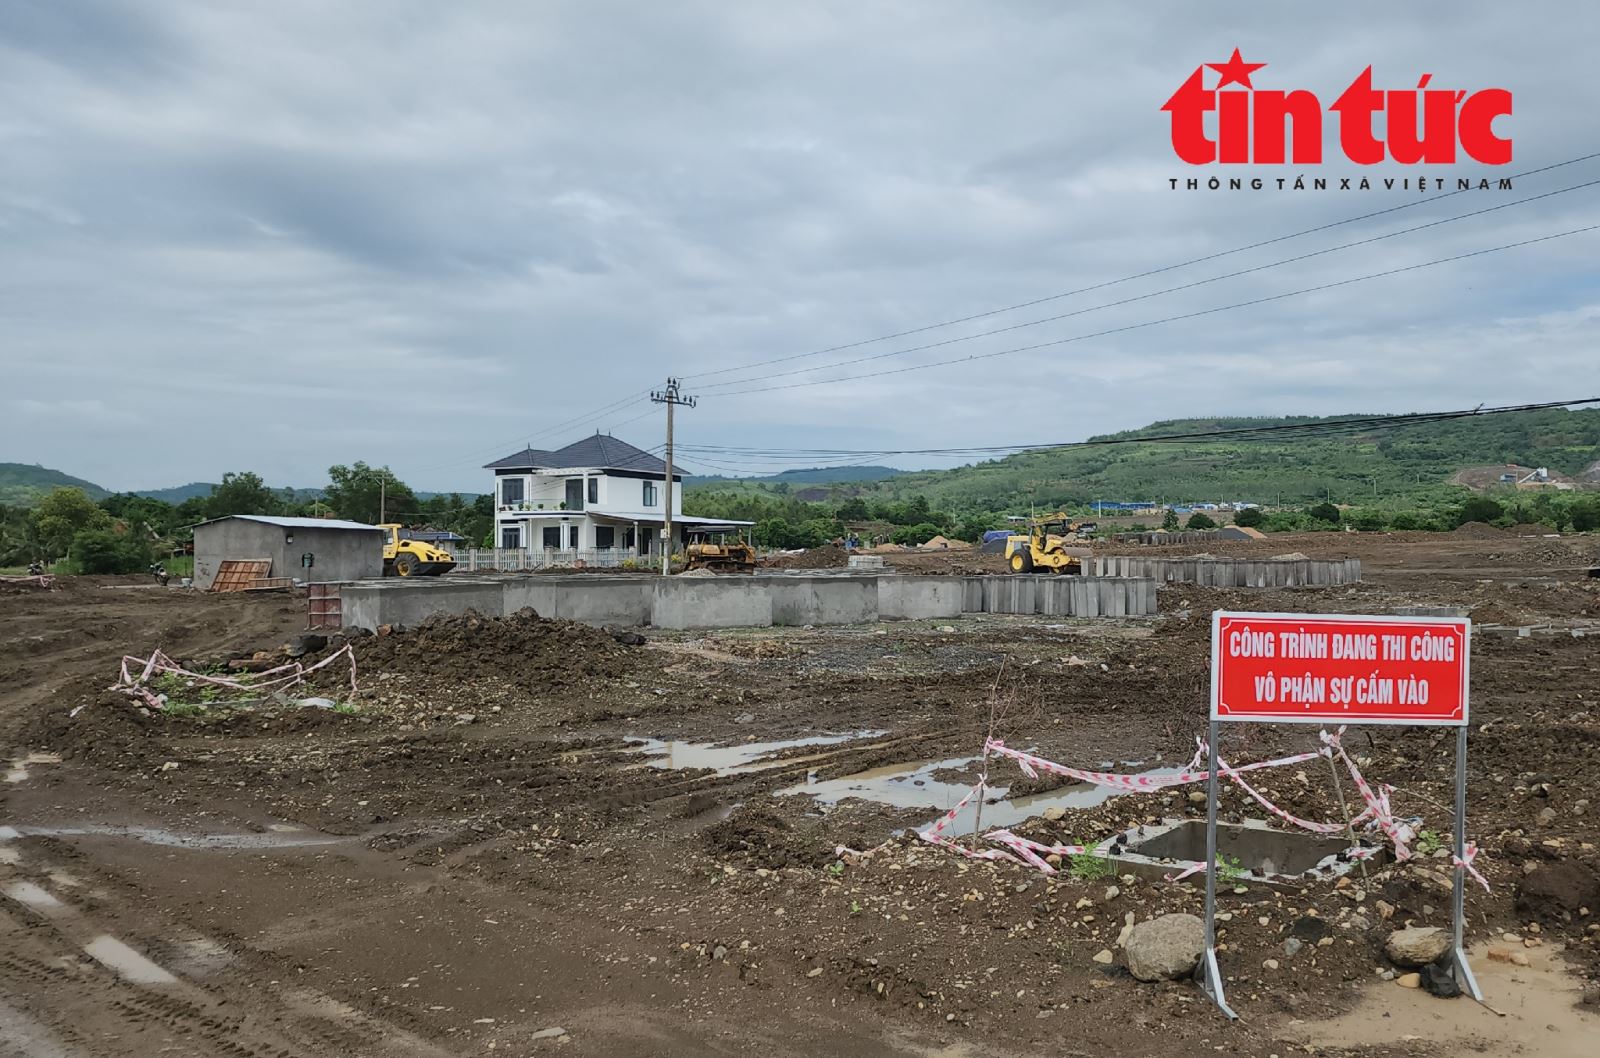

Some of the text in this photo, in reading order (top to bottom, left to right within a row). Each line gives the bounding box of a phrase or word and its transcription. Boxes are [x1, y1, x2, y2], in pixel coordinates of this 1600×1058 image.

[1229, 626, 1455, 662] CÔNG TRÌNH ĐANG THI CÔNG
[1255, 670, 1429, 709] VÔ PHẬN SỰ CẤM VÀO
